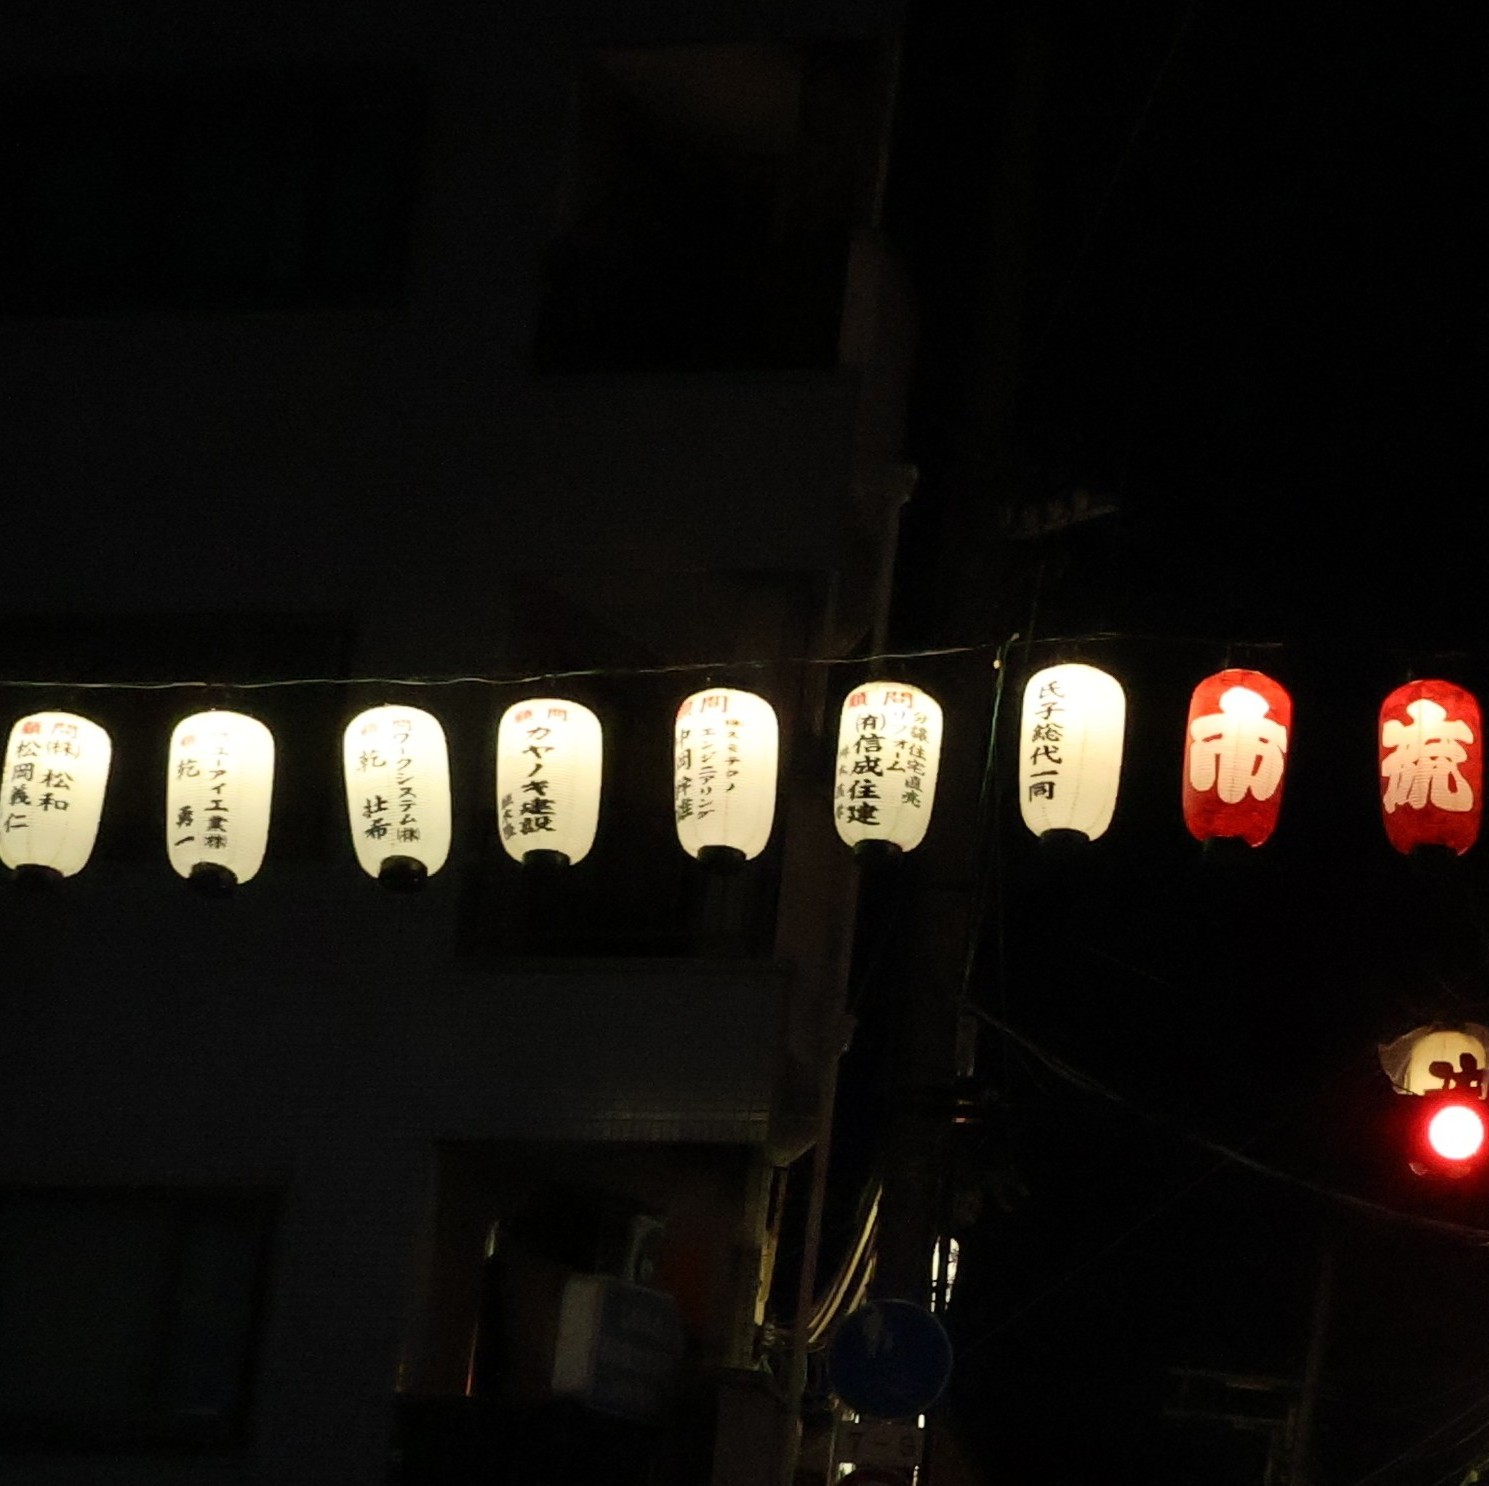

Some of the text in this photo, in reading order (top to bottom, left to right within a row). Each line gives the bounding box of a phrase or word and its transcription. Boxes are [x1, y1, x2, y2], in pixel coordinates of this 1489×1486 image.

[1029, 680, 1065, 803] 氏子総代一同
[1191, 686, 1287, 804] 市
[1382, 699, 1475, 813] 流
